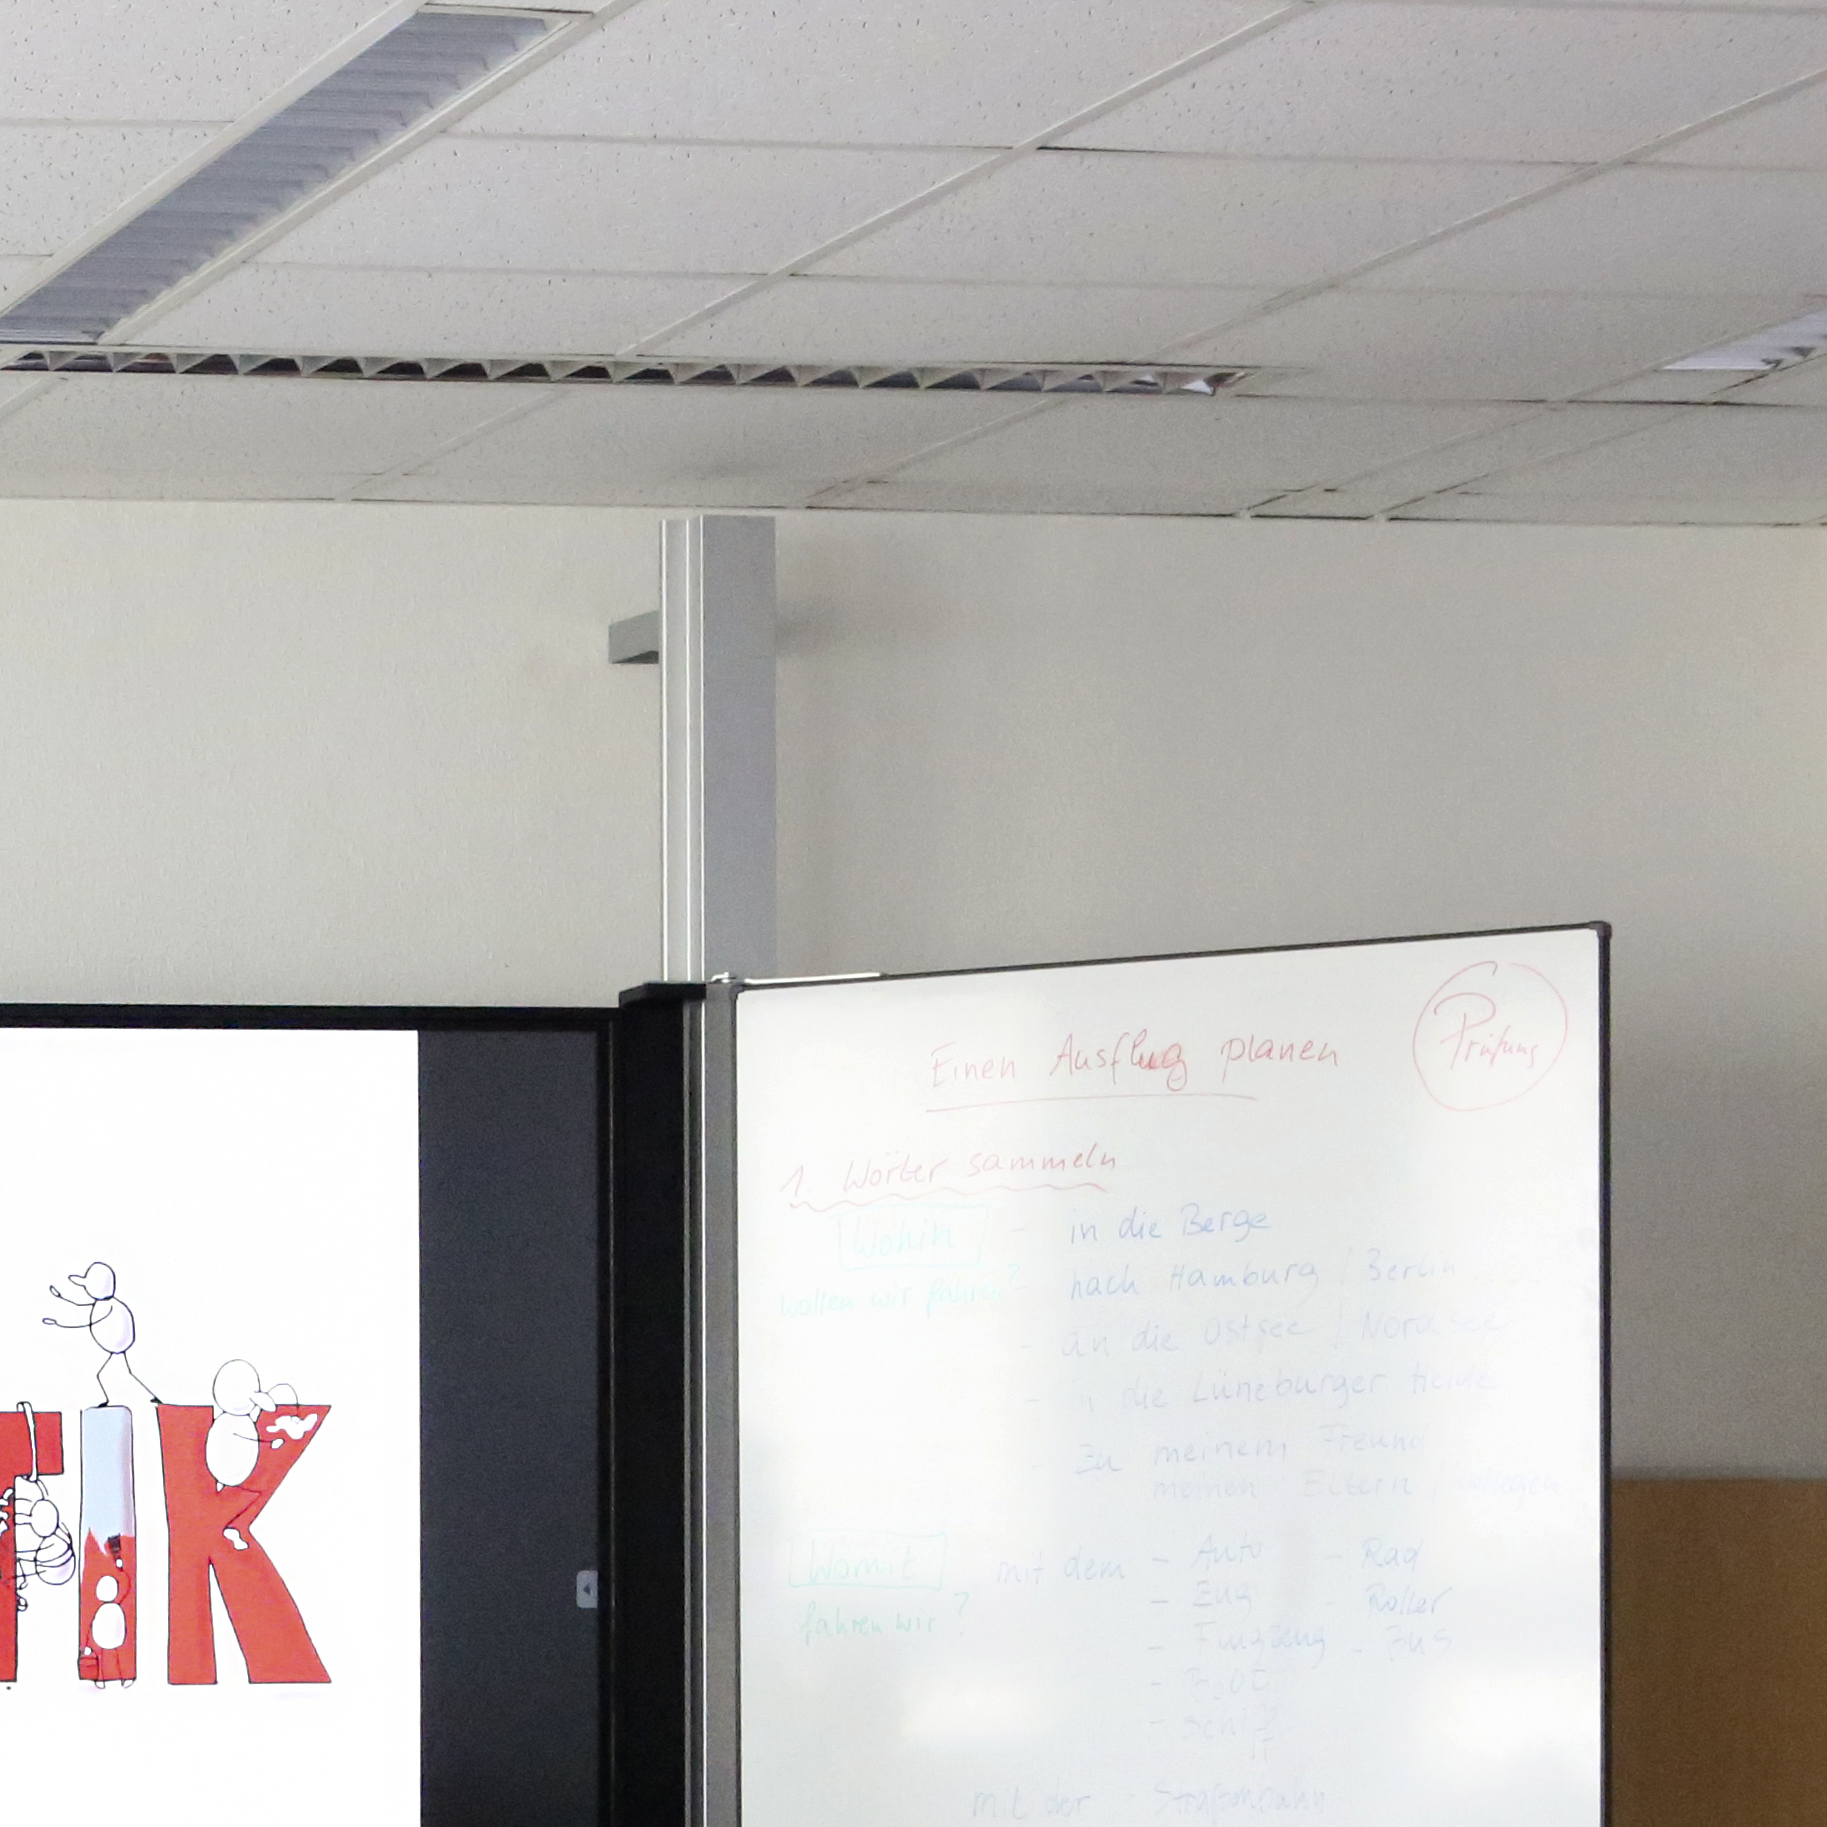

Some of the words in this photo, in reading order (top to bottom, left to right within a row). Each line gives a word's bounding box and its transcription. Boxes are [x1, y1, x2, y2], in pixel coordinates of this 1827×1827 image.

[930, 1040, 1017, 1090] Einen
[1048, 1027, 1190, 1092] Ausflug
[1220, 1035, 1341, 1083] planen
[843, 1148, 948, 1195] Wörter
[966, 1143, 1118, 1182] sammeln
[1068, 1213, 1098, 1244] in
[1118, 1205, 1163, 1241] die
[1180, 1202, 1272, 1243] Berge
[1070, 1264, 1139, 1301] nach
[1170, 1262, 1320, 1305] Hamburg
